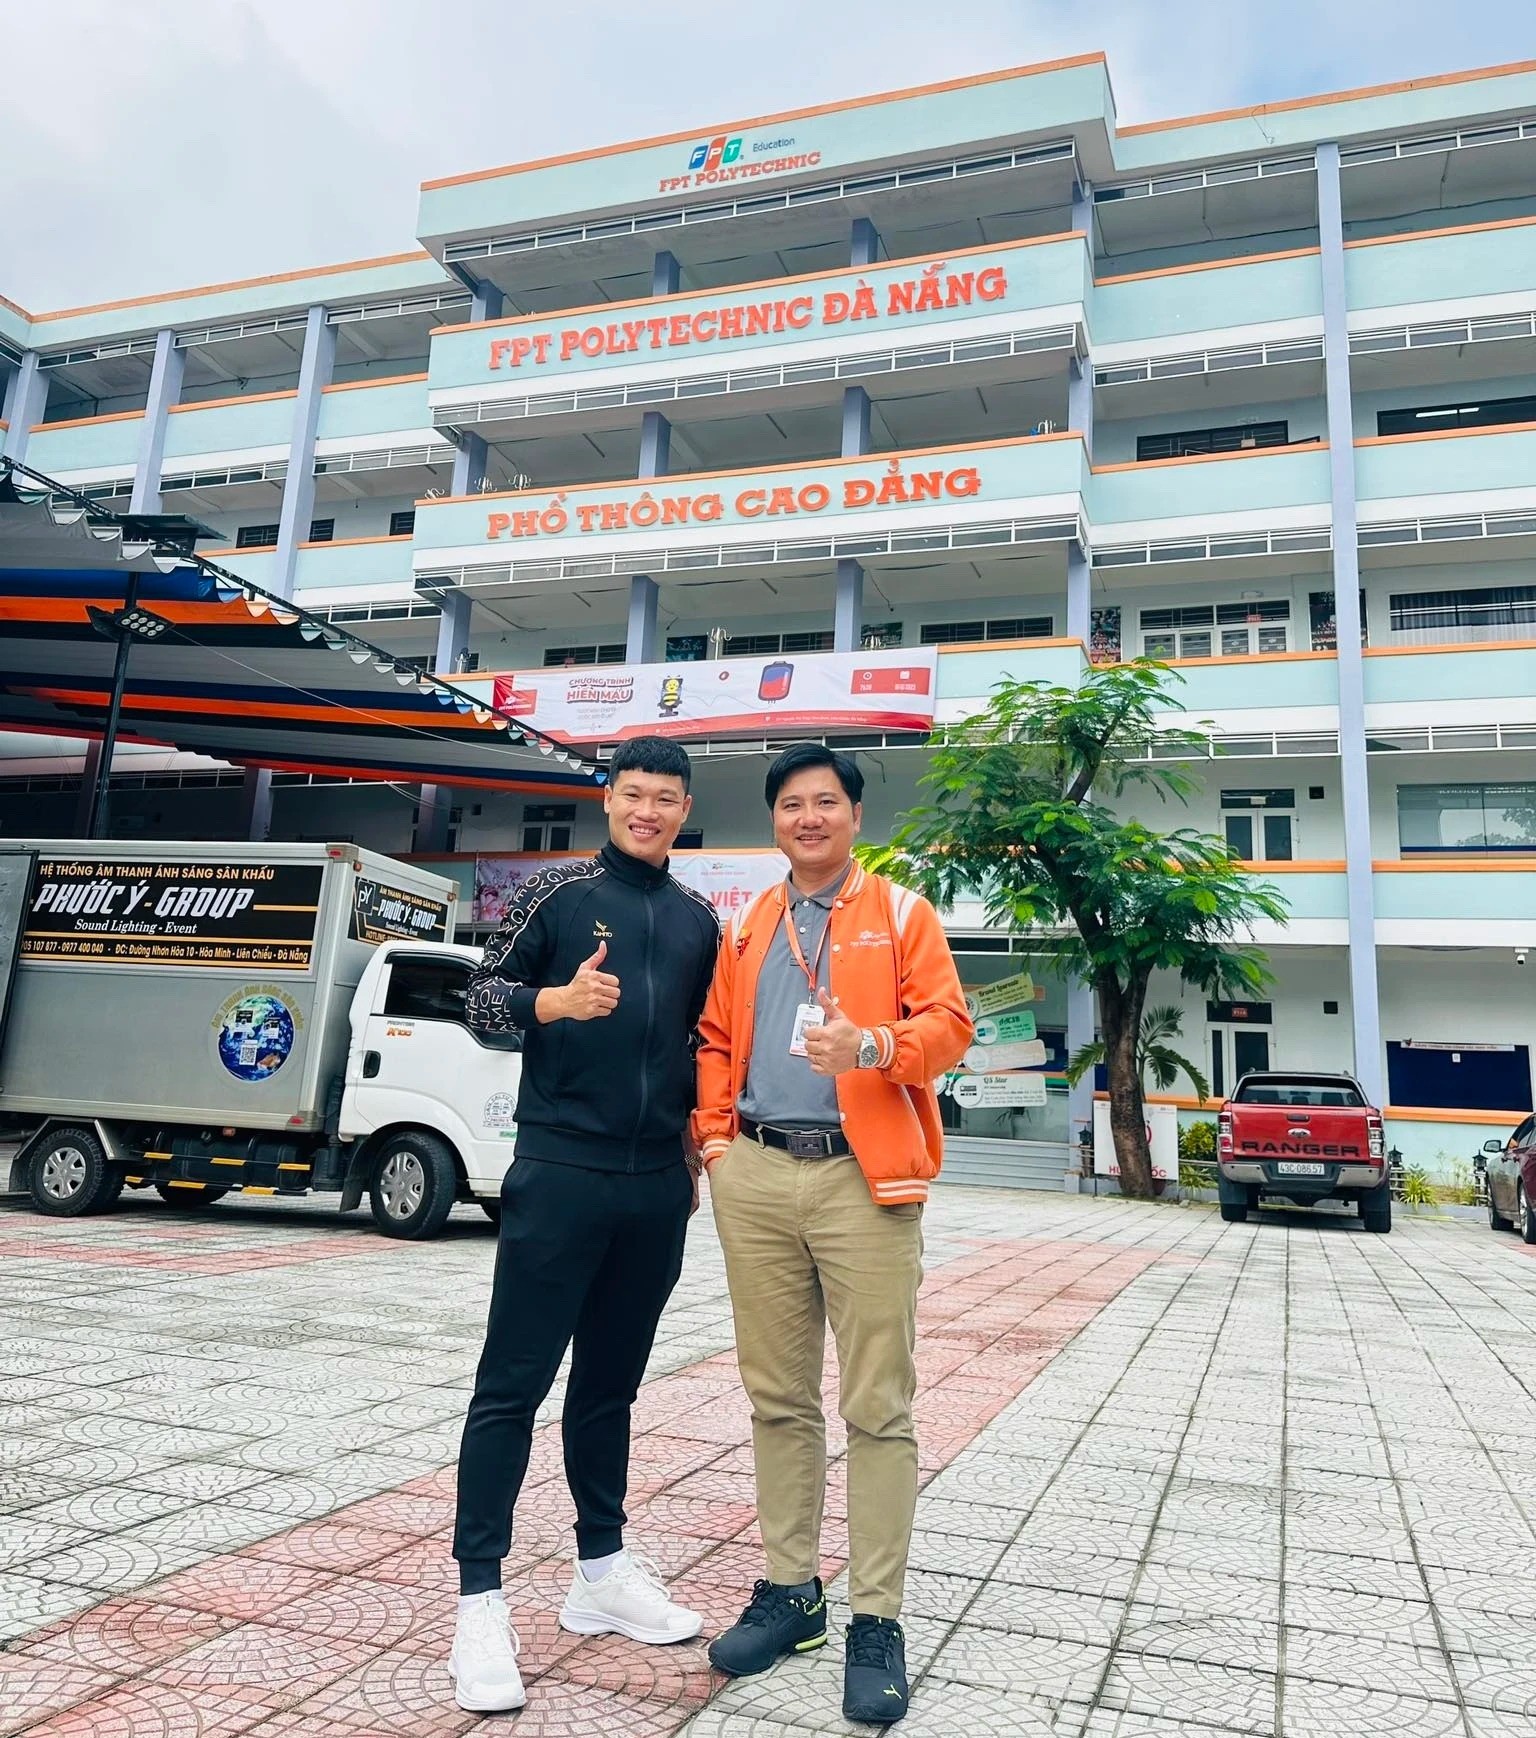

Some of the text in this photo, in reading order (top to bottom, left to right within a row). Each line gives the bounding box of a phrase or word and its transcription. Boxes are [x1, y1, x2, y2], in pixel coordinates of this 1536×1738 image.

[690, 137, 795, 167] FPT Education
[659, 152, 821, 192] FPT POLYTECHNIC
[490, 261, 1007, 369] FPT POLYTECHNIC ĐÀ NẴNG
[487, 458, 981, 539] PHỔ THÔNG CAO ĐẲNG
[40, 862, 275, 880] HỆ THỐNG ÂM THANH ÁNH SÁNG SÂN KHẤU
[33, 879, 125, 914] PHƯỚC
[155, 886, 253, 919] GROUP
[710, 885, 753, 911] VIỆT
[74, 918, 108, 931] Sound
[110, 919, 158, 935] Lighting
[164, 921, 198, 934] Event
[33, 941, 44, 951] 107
[45, 942, 58, 952] 877
[62, 942, 78, 952] 0977
[78, 943, 91, 953] 400
[91, 943, 104, 954] 040
[115, 943, 129, 955] ĐC:
[129, 944, 151, 957] Đường
[186, 946, 195, 957] 10
[199, 946, 213, 957] Hòa
[214, 947, 231, 958] Minh
[236, 948, 251, 959] Liên
[252, 946, 272, 960] Chiểu
[277, 949, 288, 960] Đà
[289, 948, 309, 963] Nẵng
[1241, 1141, 1359, 1157] RANGER
